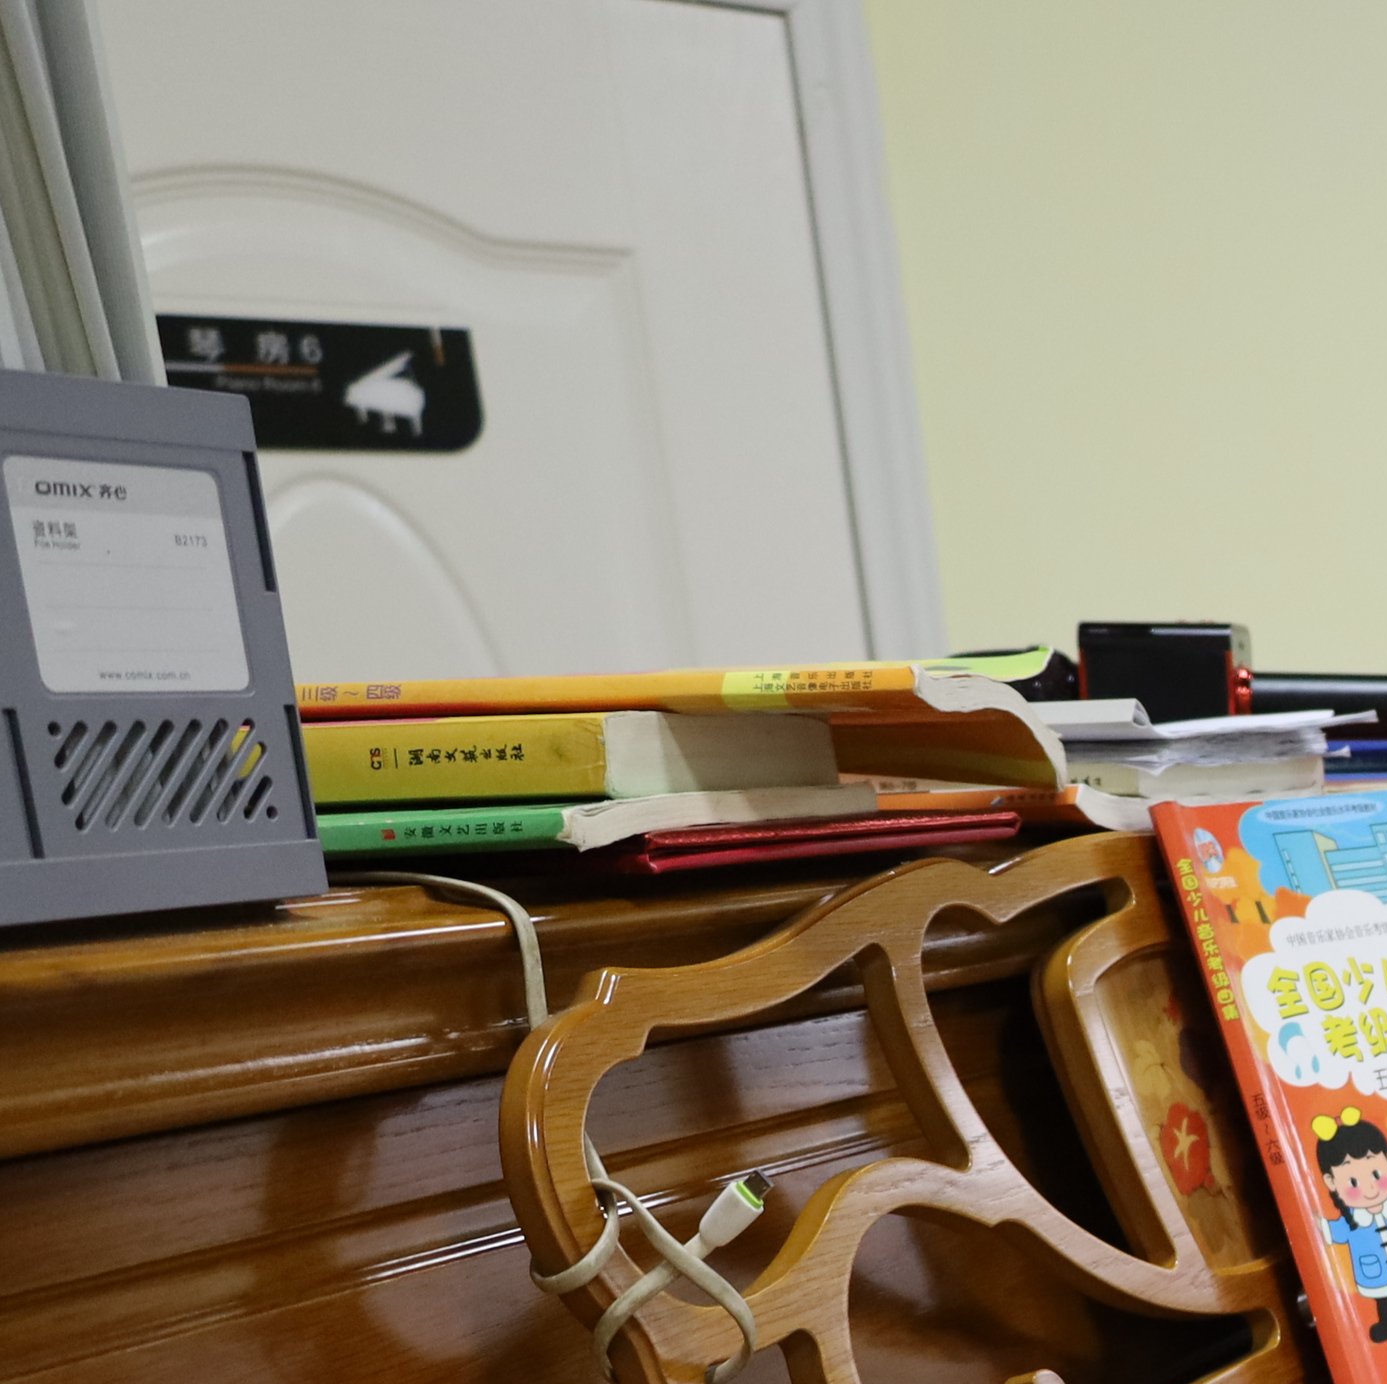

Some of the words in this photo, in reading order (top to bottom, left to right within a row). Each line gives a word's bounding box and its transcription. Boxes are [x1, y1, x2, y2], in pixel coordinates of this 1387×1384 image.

[174, 534, 208, 548] B2173
[753, 669, 873, 682] 上海音乐出版社
[404, 820, 523, 840] 安徽文艺出版社
